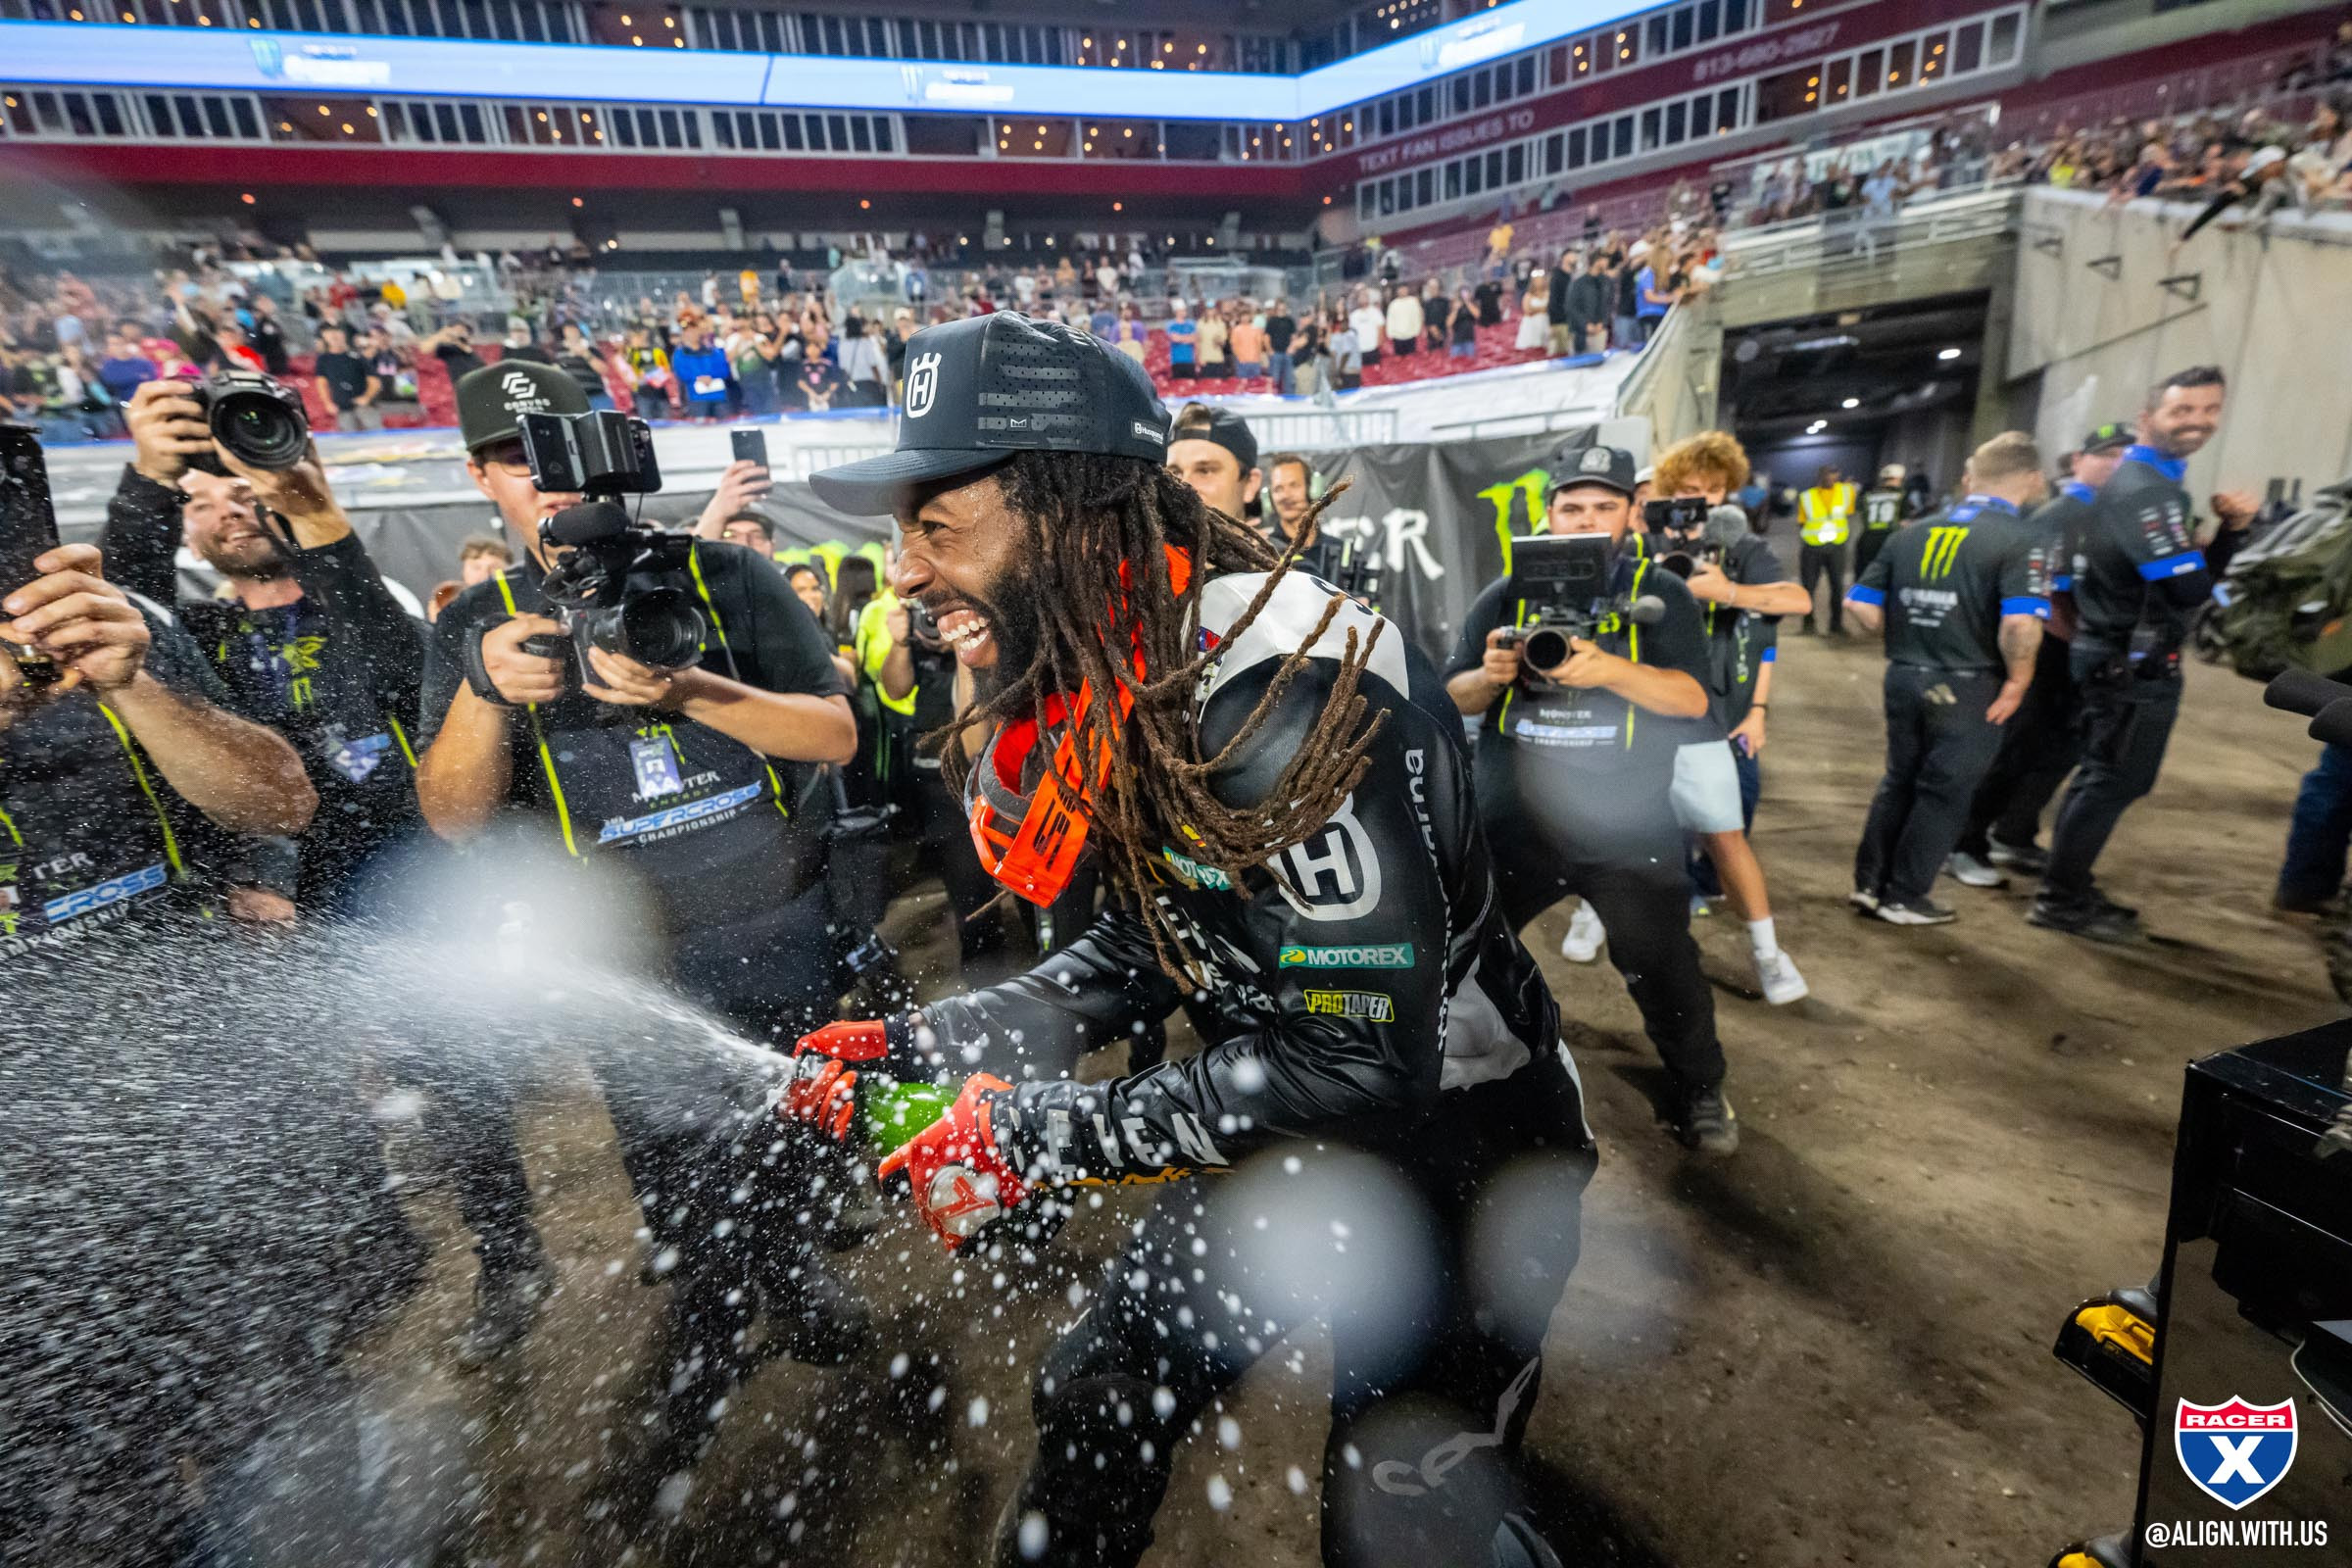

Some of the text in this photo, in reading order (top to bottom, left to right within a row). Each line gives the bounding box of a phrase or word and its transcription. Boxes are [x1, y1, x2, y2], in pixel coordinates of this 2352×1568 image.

[1358, 148, 1398, 173] TEXT
[1400, 138, 1438, 161] FAN
[1507, 108, 1536, 131] TO
[631, 770, 721, 804] MTER
[601, 783, 762, 840] SUPERCROSS
[638, 808, 737, 844] CHAMPIONSHIP
[1307, 947, 1408, 966] MOTOREX
[1310, 993, 1390, 1021] PROTAPER
